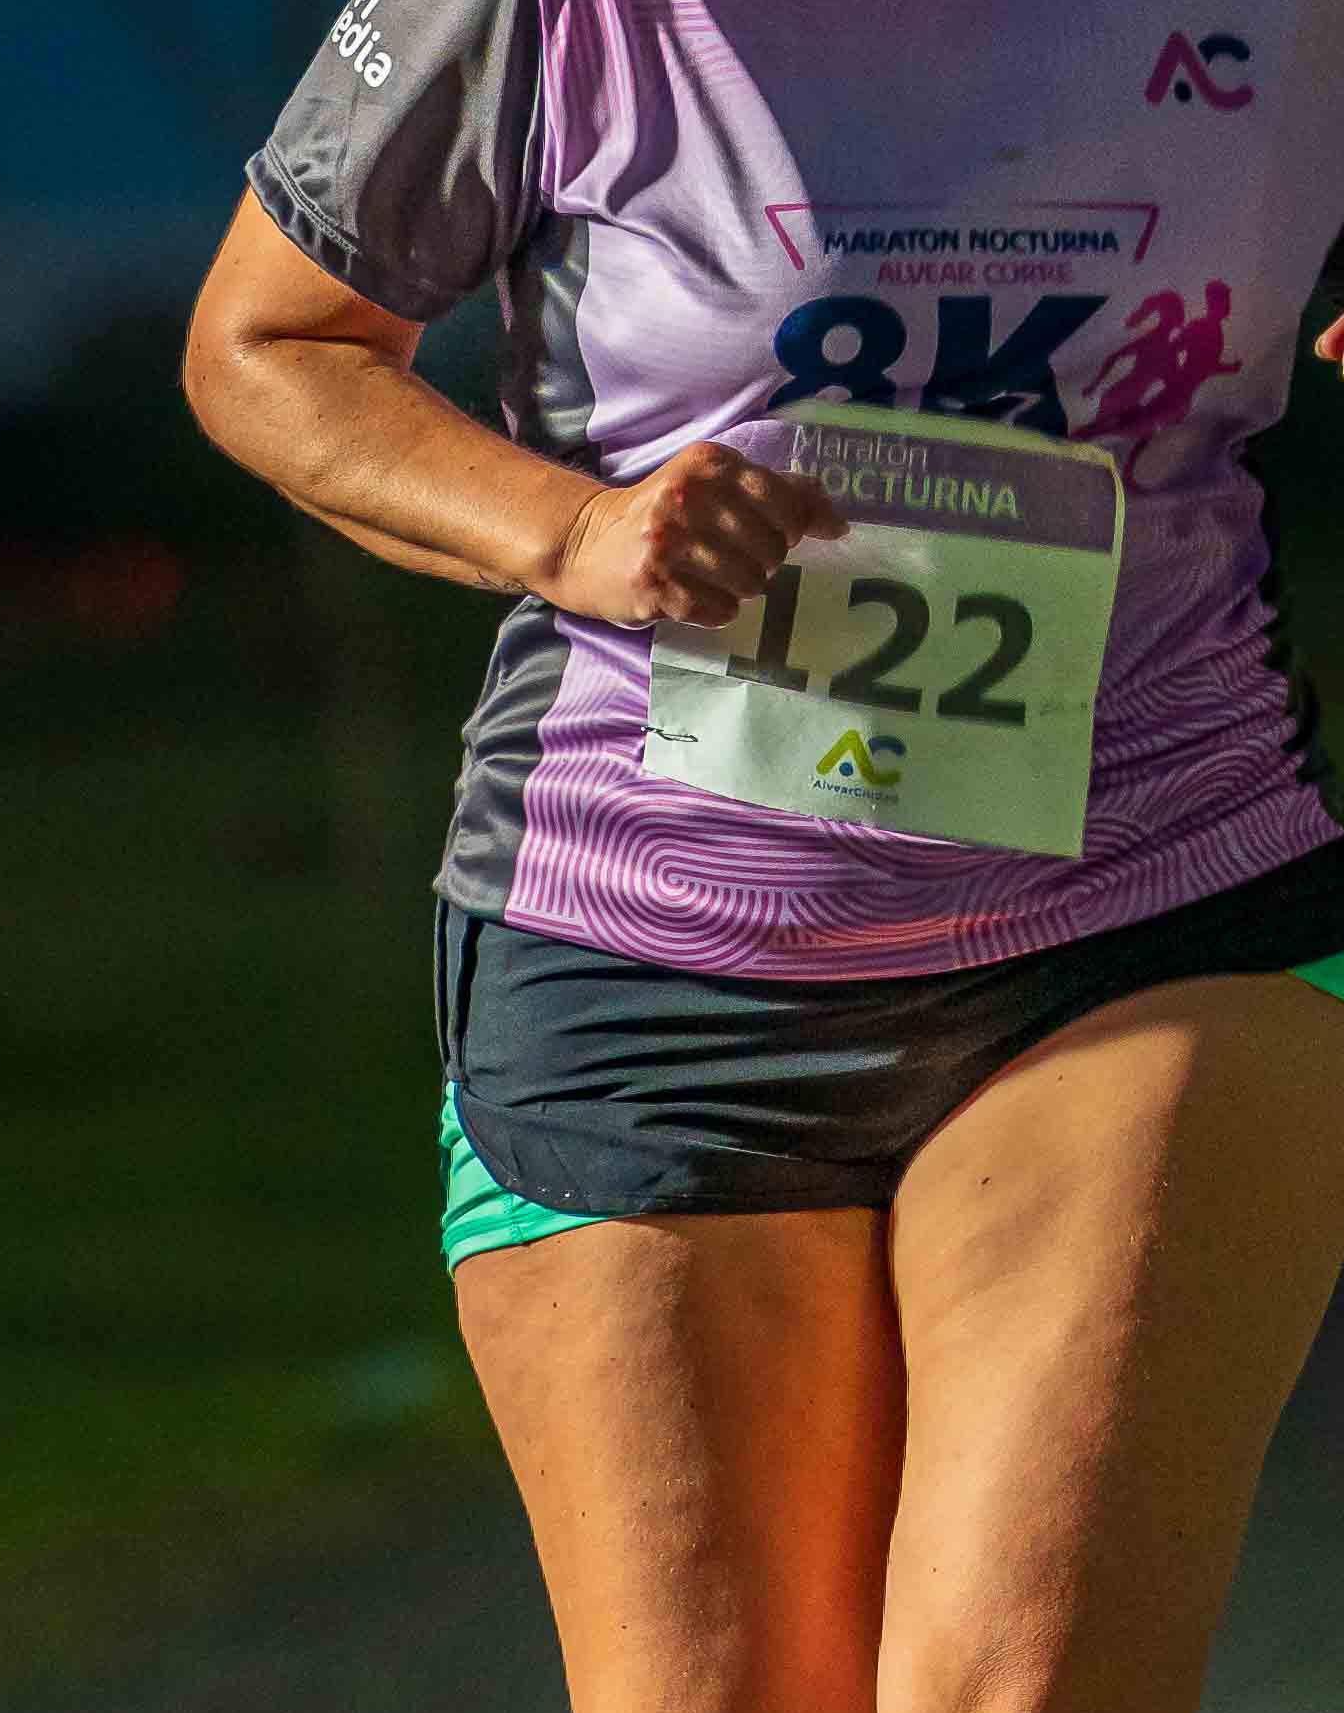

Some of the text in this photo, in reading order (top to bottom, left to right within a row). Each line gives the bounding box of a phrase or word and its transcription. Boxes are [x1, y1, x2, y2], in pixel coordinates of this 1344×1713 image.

[1143, 30, 1254, 110] AC
[968, 228, 1120, 254] NOCTURNA
[876, 260, 976, 286] ALVEAR
[726, 564, 1033, 726] 122
